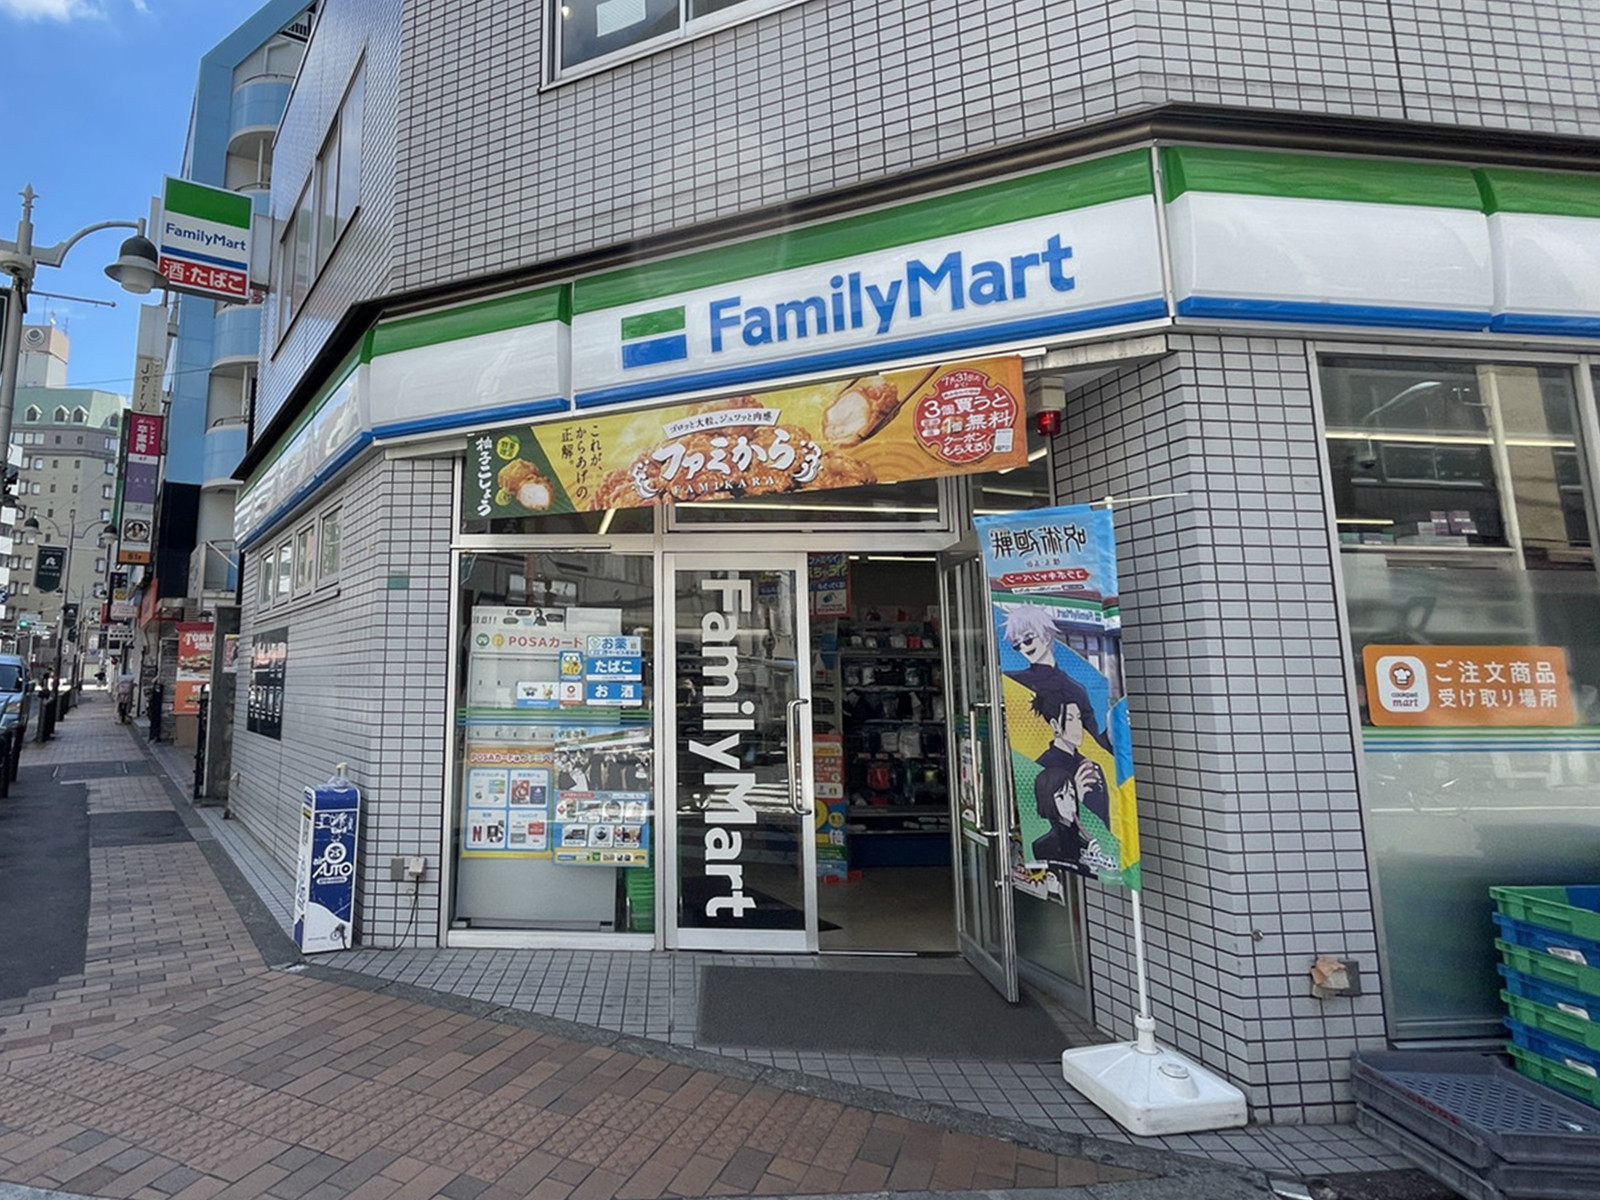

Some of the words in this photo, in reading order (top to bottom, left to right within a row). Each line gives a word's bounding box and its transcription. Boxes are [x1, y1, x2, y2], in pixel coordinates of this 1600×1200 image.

[166, 222, 246, 251] FamilyMart
[163, 259, 243, 292] 酒・たばこ
[709, 233, 1075, 353] FamilyMart
[924, 392, 1009, 418] 3個買うと
[944, 432, 986, 446] クーポン
[575, 427, 588, 499] からあげの
[475, 436, 493, 517] 柚子こしょう
[673, 475, 776, 495] FAMIKARA
[508, 636, 583, 648] POSAカード
[595, 660, 633, 673] たばこ
[1434, 659, 1556, 684] ご注文商品
[1392, 697, 1419, 708] mart
[1438, 688, 1557, 708] 受け取り場所
[688, 579, 757, 918] FamilyMart
[312, 861, 353, 878] AUTO
